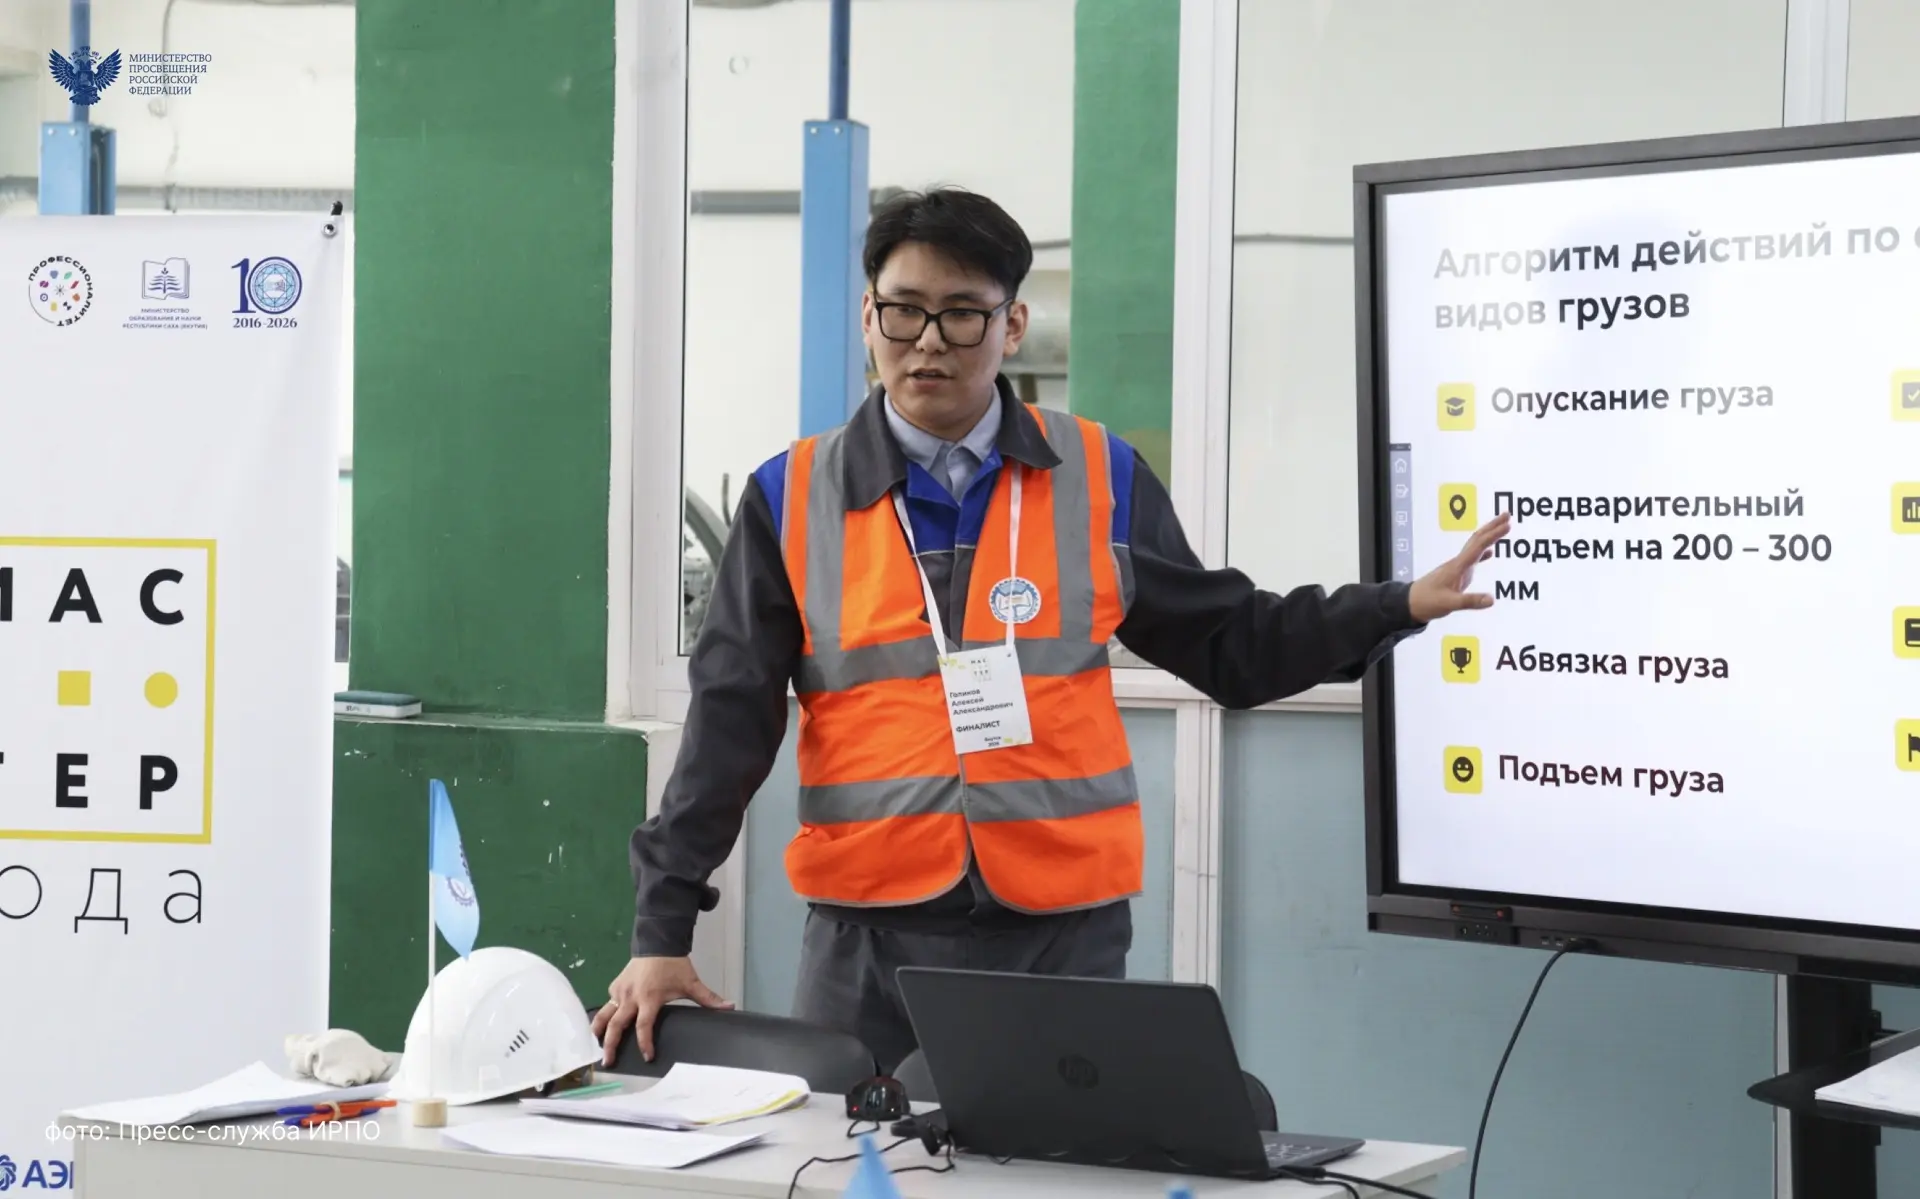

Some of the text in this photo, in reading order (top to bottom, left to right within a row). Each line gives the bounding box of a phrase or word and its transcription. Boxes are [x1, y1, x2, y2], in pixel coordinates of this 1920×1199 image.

[1434, 244, 1619, 281] Алгоритм
[1631, 221, 1831, 273] действий
[1847, 226, 1900, 255] по
[28, 255, 93, 326] ПРОФЕССИОНАЛИТЕТ
[1435, 293, 1690, 331] видов грузов
[1492, 385, 1774, 419] Опускание груза
[1494, 488, 1804, 524] Предварительный
[1494, 539, 1614, 563] подъем
[1625, 539, 1662, 560] на
[1672, 533, 1734, 561] 200
[1768, 533, 1833, 563] 300
[1495, 580, 1540, 601] мм
[1496, 643, 1730, 685] Абвязка груза
[956, 720, 1001, 733] ФИНАЛИСТ
[0, 752, 179, 810] ЕР
[1499, 755, 1725, 799] Подъем груза
